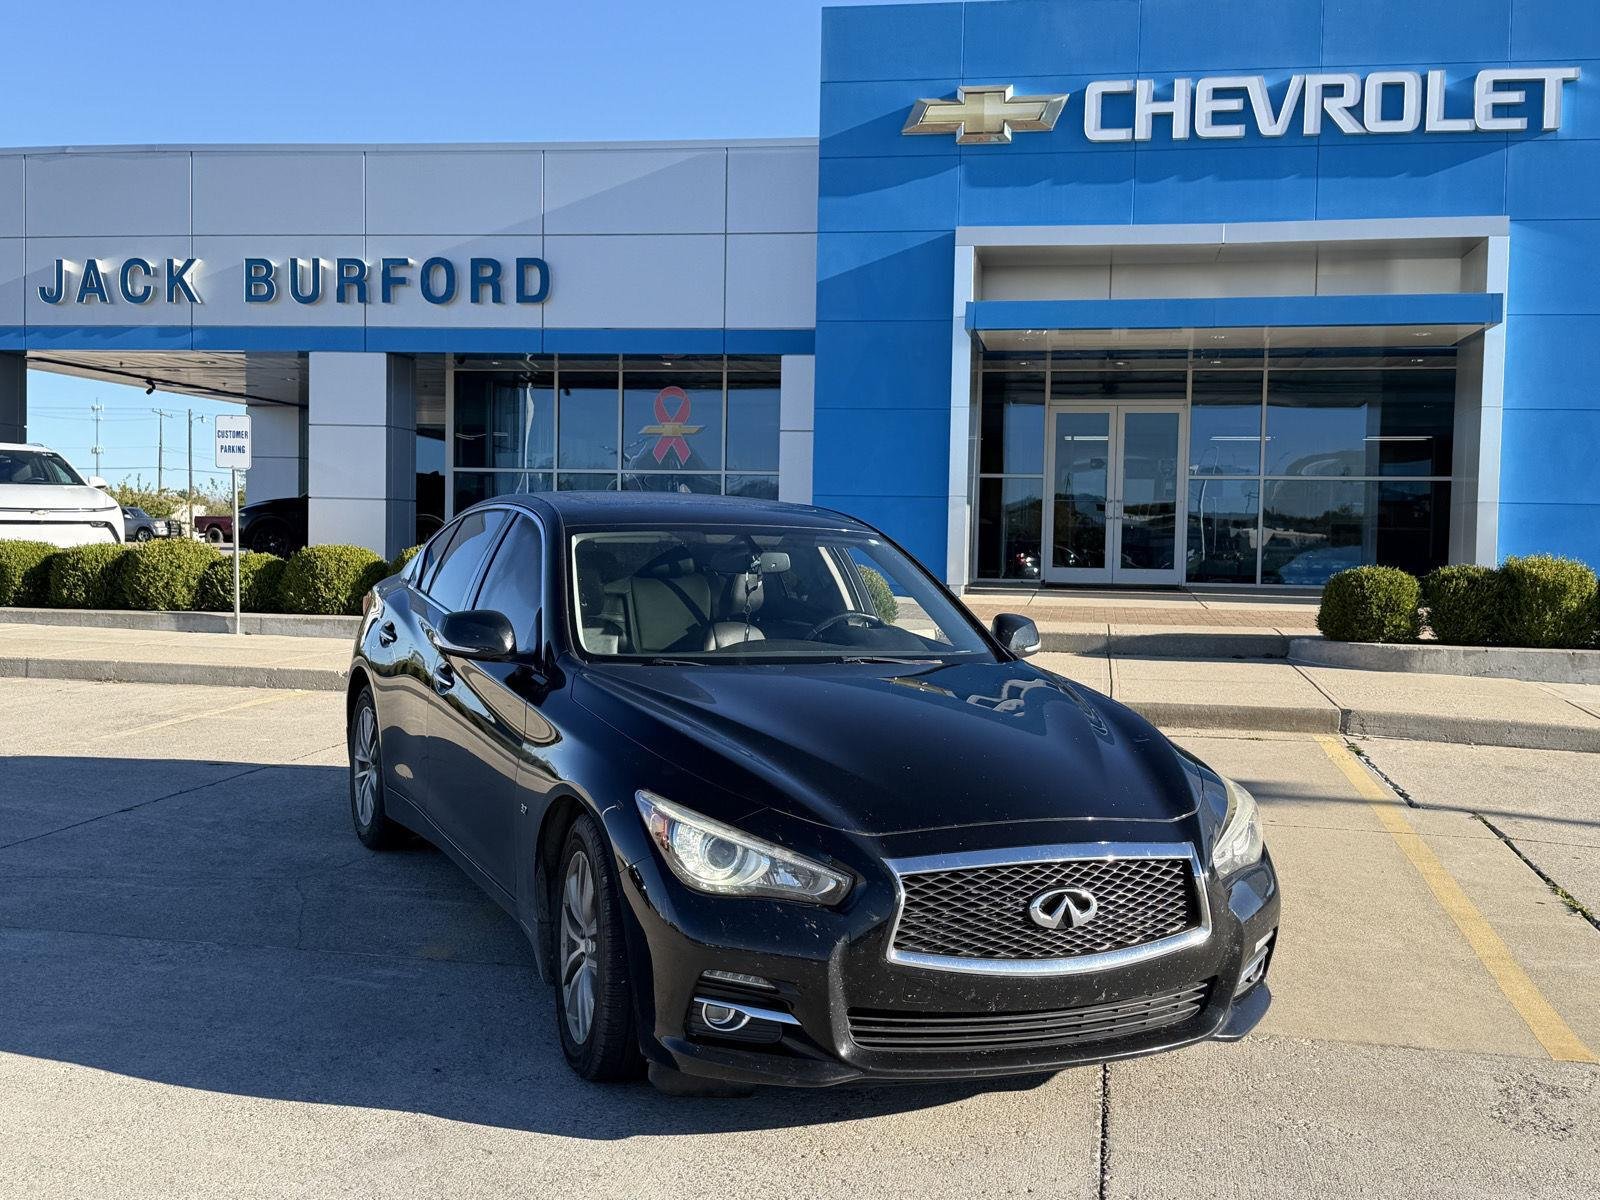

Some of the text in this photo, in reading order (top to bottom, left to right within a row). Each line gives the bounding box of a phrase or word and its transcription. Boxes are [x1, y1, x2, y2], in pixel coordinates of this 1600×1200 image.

[1084, 67, 1581, 142] CHEVROLET
[38, 257, 551, 305] JACK BURFORD
[217, 430, 249, 439] CUSTOMER
[220, 445, 246, 454] PARKING
